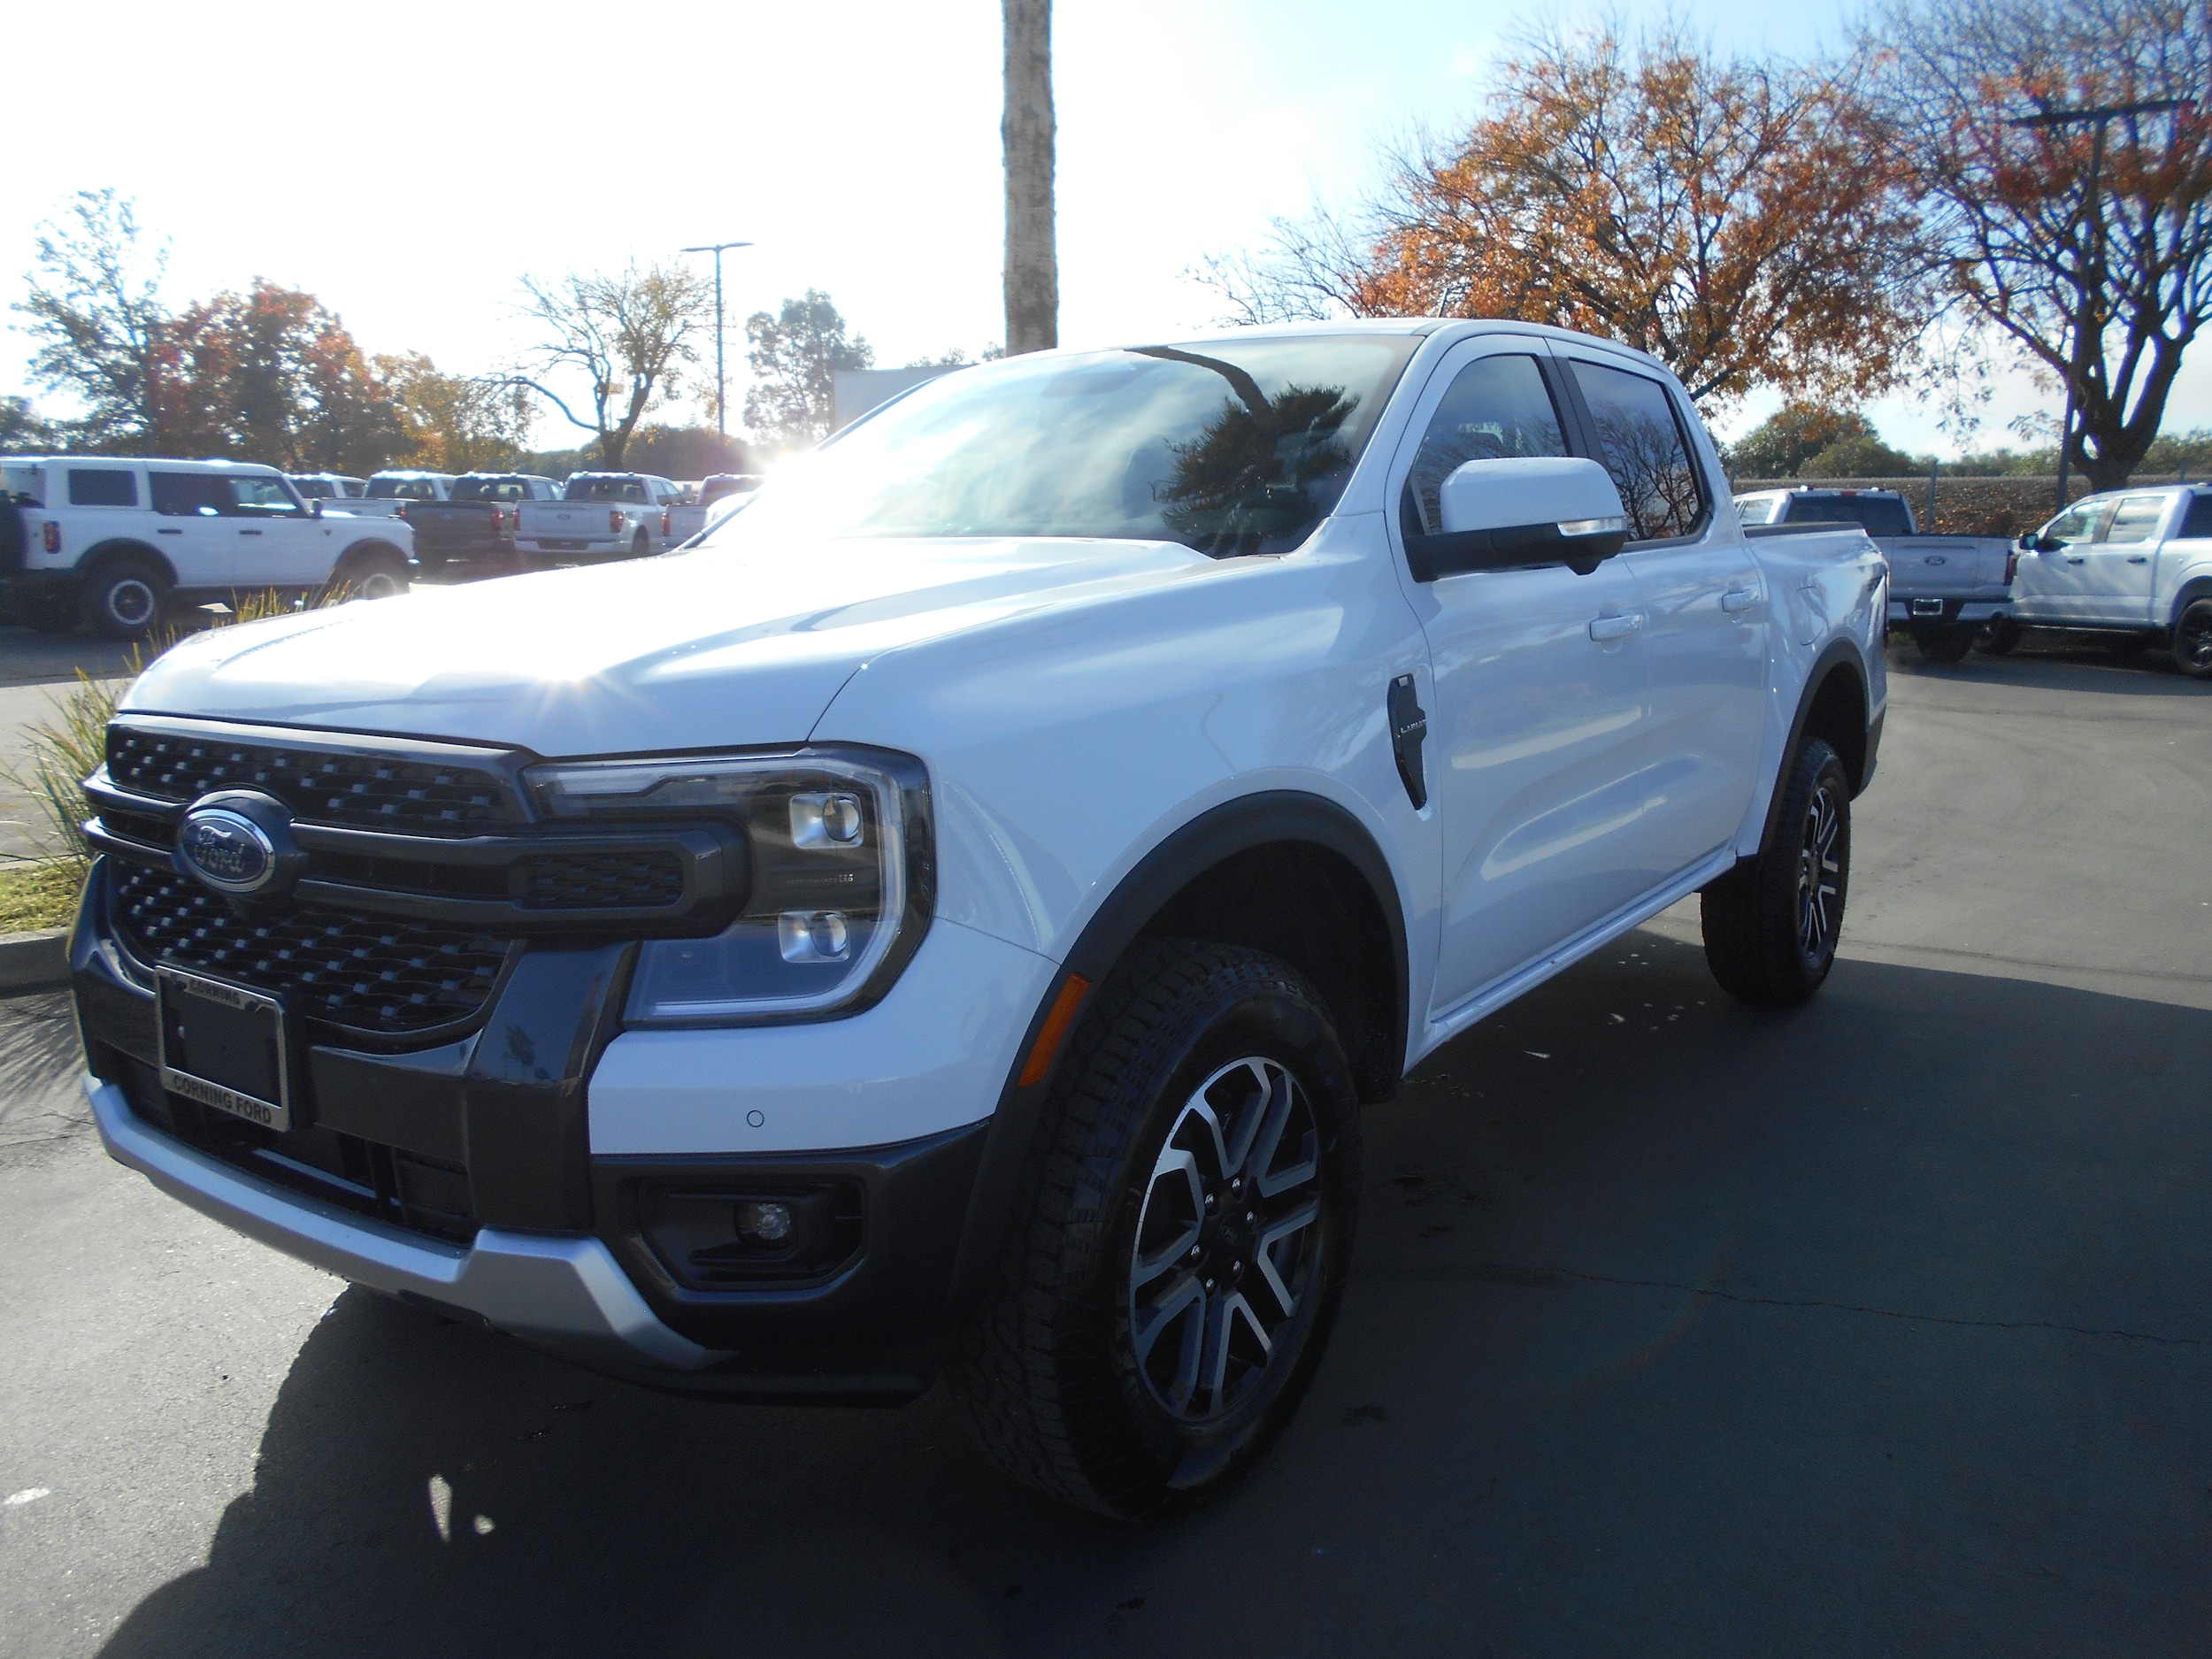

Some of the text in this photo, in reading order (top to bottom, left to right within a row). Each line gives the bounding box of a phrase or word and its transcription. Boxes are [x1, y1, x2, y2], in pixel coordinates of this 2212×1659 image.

[1400, 719, 1426, 733] LARIAT
[194, 825, 246, 873] Ford
[189, 978, 241, 1004] CORNING
[173, 1074, 272, 1125] CORNING FORD
